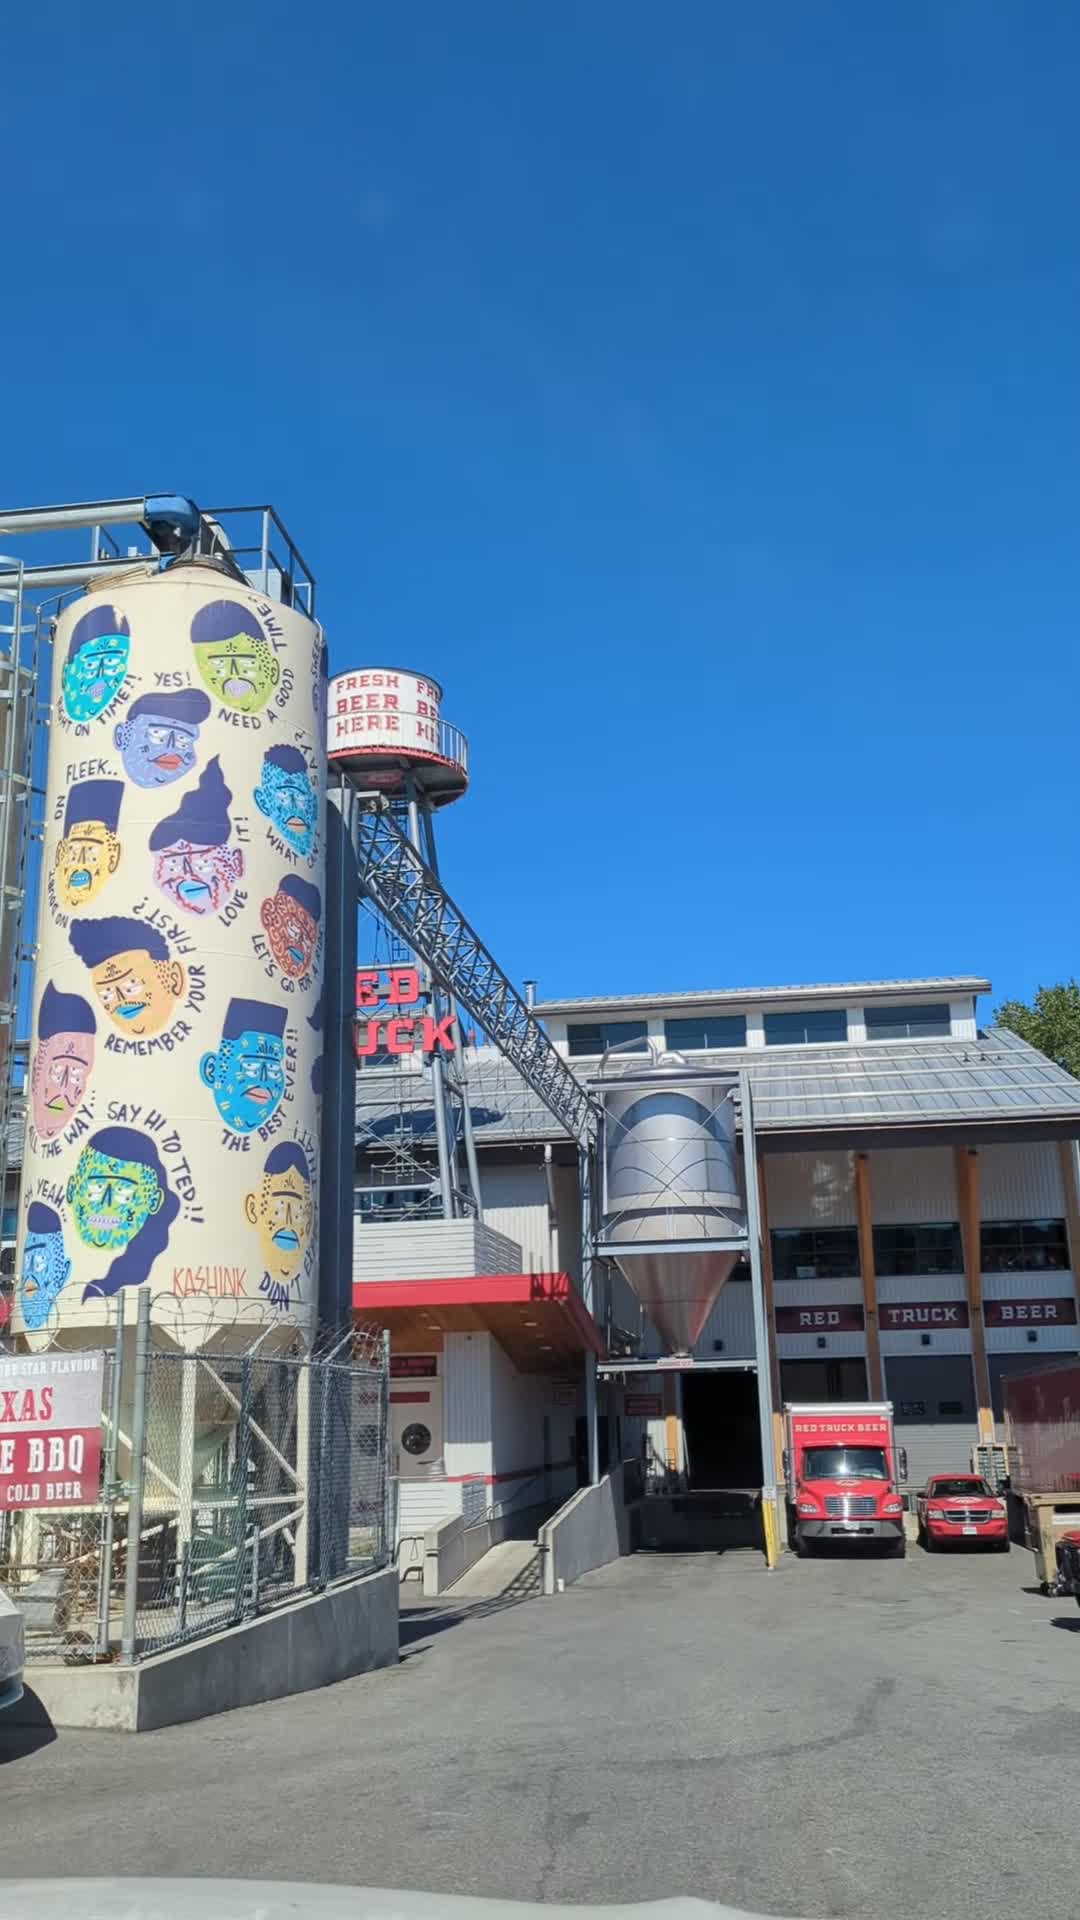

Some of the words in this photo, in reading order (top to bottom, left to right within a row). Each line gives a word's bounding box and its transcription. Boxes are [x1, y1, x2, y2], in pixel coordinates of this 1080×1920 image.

[153, 671, 192, 687] YES!
[336, 673, 399, 694] FRESH
[218, 707, 262, 730] NEED
[266, 708, 280, 725] A
[275, 668, 295, 708] GOOD
[336, 693, 399, 715] BEER
[74, 722, 90, 737] ON
[336, 714, 399, 738] HERE
[265, 825, 300, 867] WHAT
[218, 889, 248, 928] LOVE
[251, 934, 279, 978] LET'S
[280, 977, 295, 993] GO
[103, 1020, 193, 1056] REMEMBER
[184, 964, 206, 1014] YOUR
[107, 1101, 142, 1123] SAY
[144, 1109, 167, 1132] HI
[162, 1130, 182, 1154] TO
[221, 1129, 251, 1152] THE
[257, 1104, 288, 1142] BEST
[41, 1140, 63, 1159] THE
[173, 1266, 247, 1297] KASHINK
[258, 1271, 302, 1311] DIDN'T
[800, 1311, 841, 1326] RED
[888, 1307, 959, 1323] TRUCK
[1000, 1304, 1059, 1320] BEER
[51, 1358, 98, 1374] FLAVOUR
[795, 1423, 817, 1433] RED
[819, 1423, 855, 1433] TRUCK
[857, 1423, 887, 1432] BEER
[27, 1434, 85, 1474] BBQ
[7, 1483, 41, 1502] COLD
[46, 1481, 83, 1501] BEER
